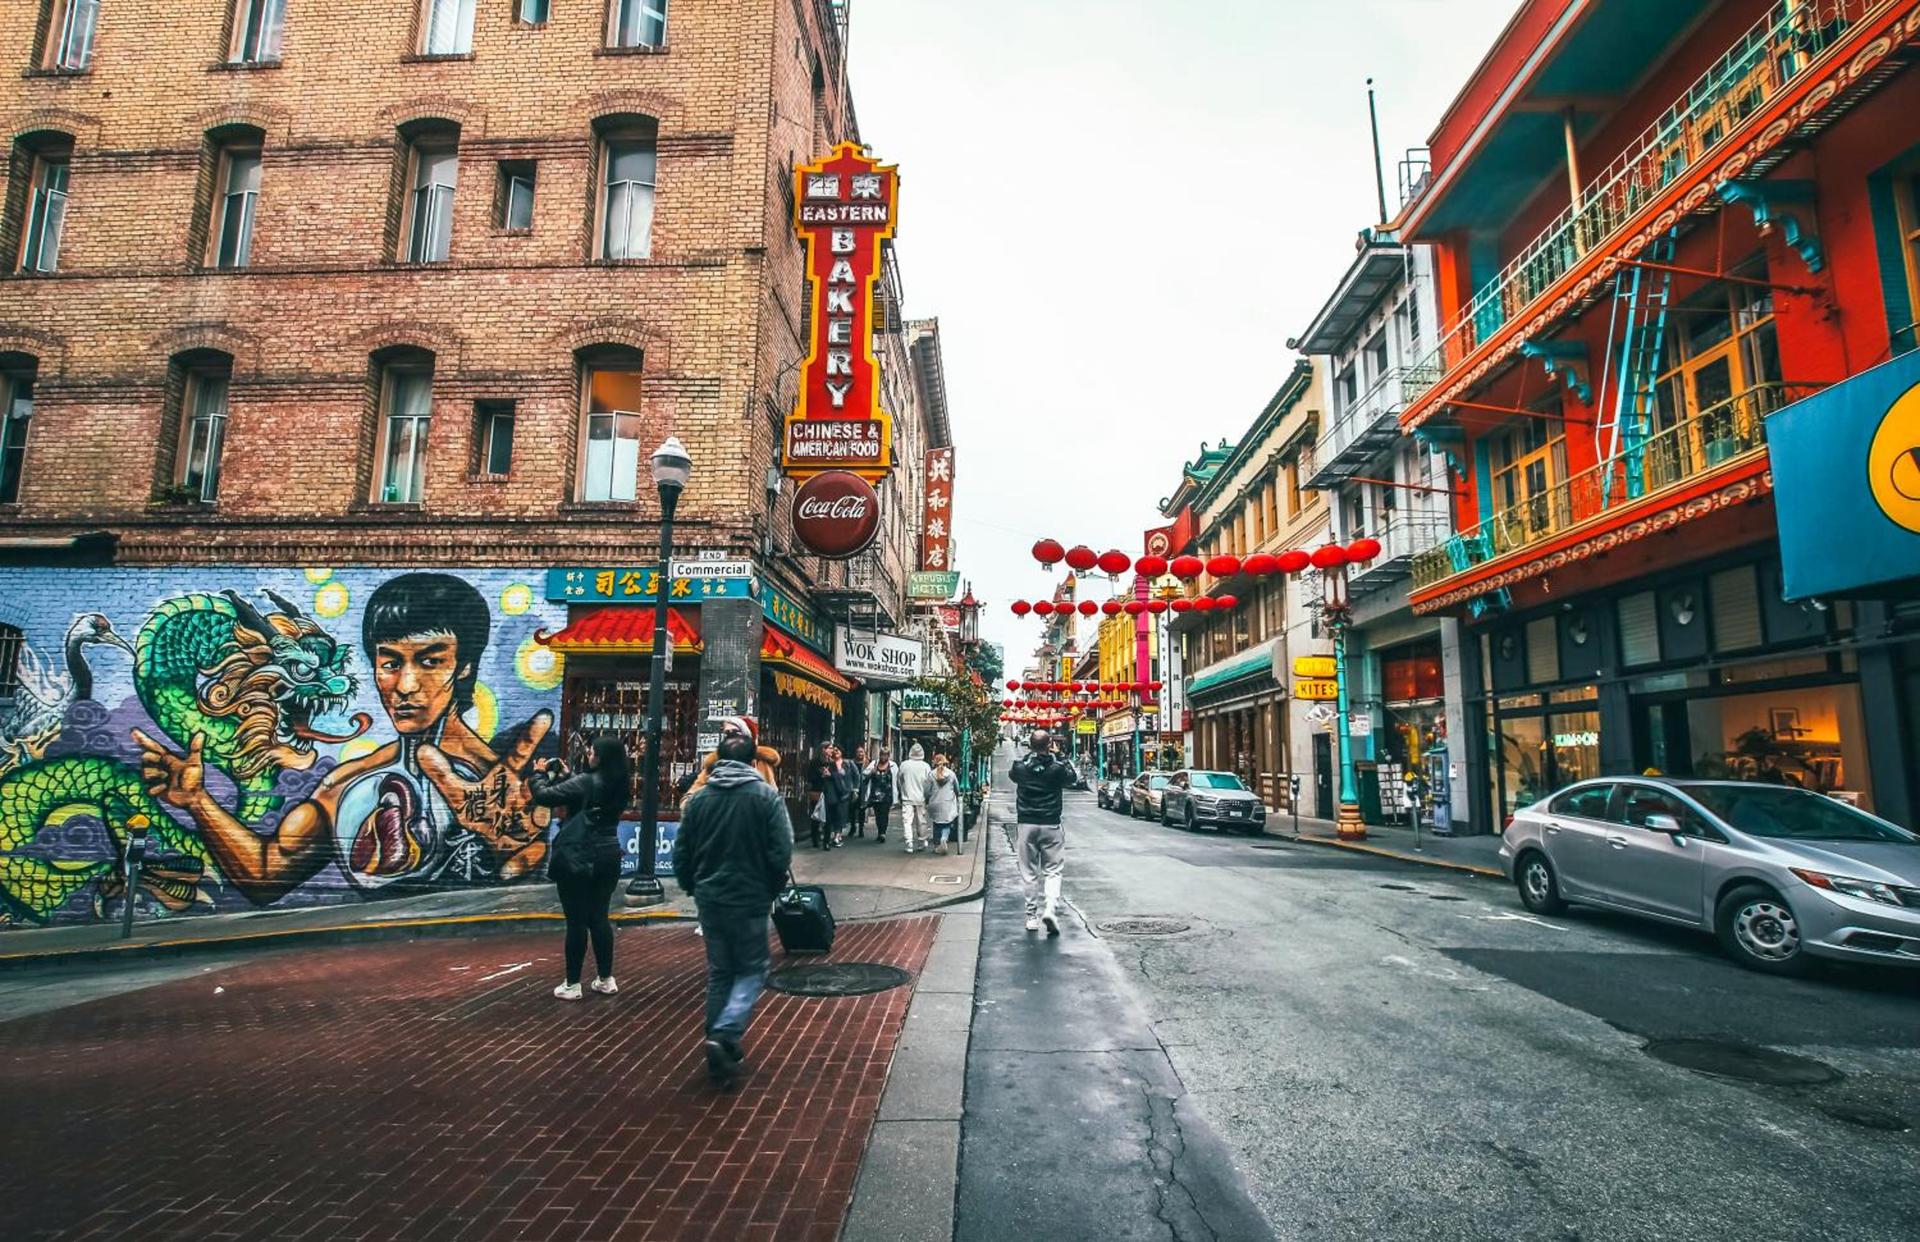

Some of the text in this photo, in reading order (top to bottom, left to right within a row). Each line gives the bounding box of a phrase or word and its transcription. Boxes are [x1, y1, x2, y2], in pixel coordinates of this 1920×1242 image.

[803, 206, 887, 221] EASTERN
[826, 229, 856, 408] BAKERY
[793, 423, 879, 440] CHINESE &
[792, 441, 879, 457] AMERICAN FOOD
[798, 496, 868, 519] Coca-Cola
[677, 564, 747, 575] Commercial
[844, 630, 855, 641] te
[844, 641, 916, 667] WOK SHOP
[1301, 684, 1335, 695] KITES
